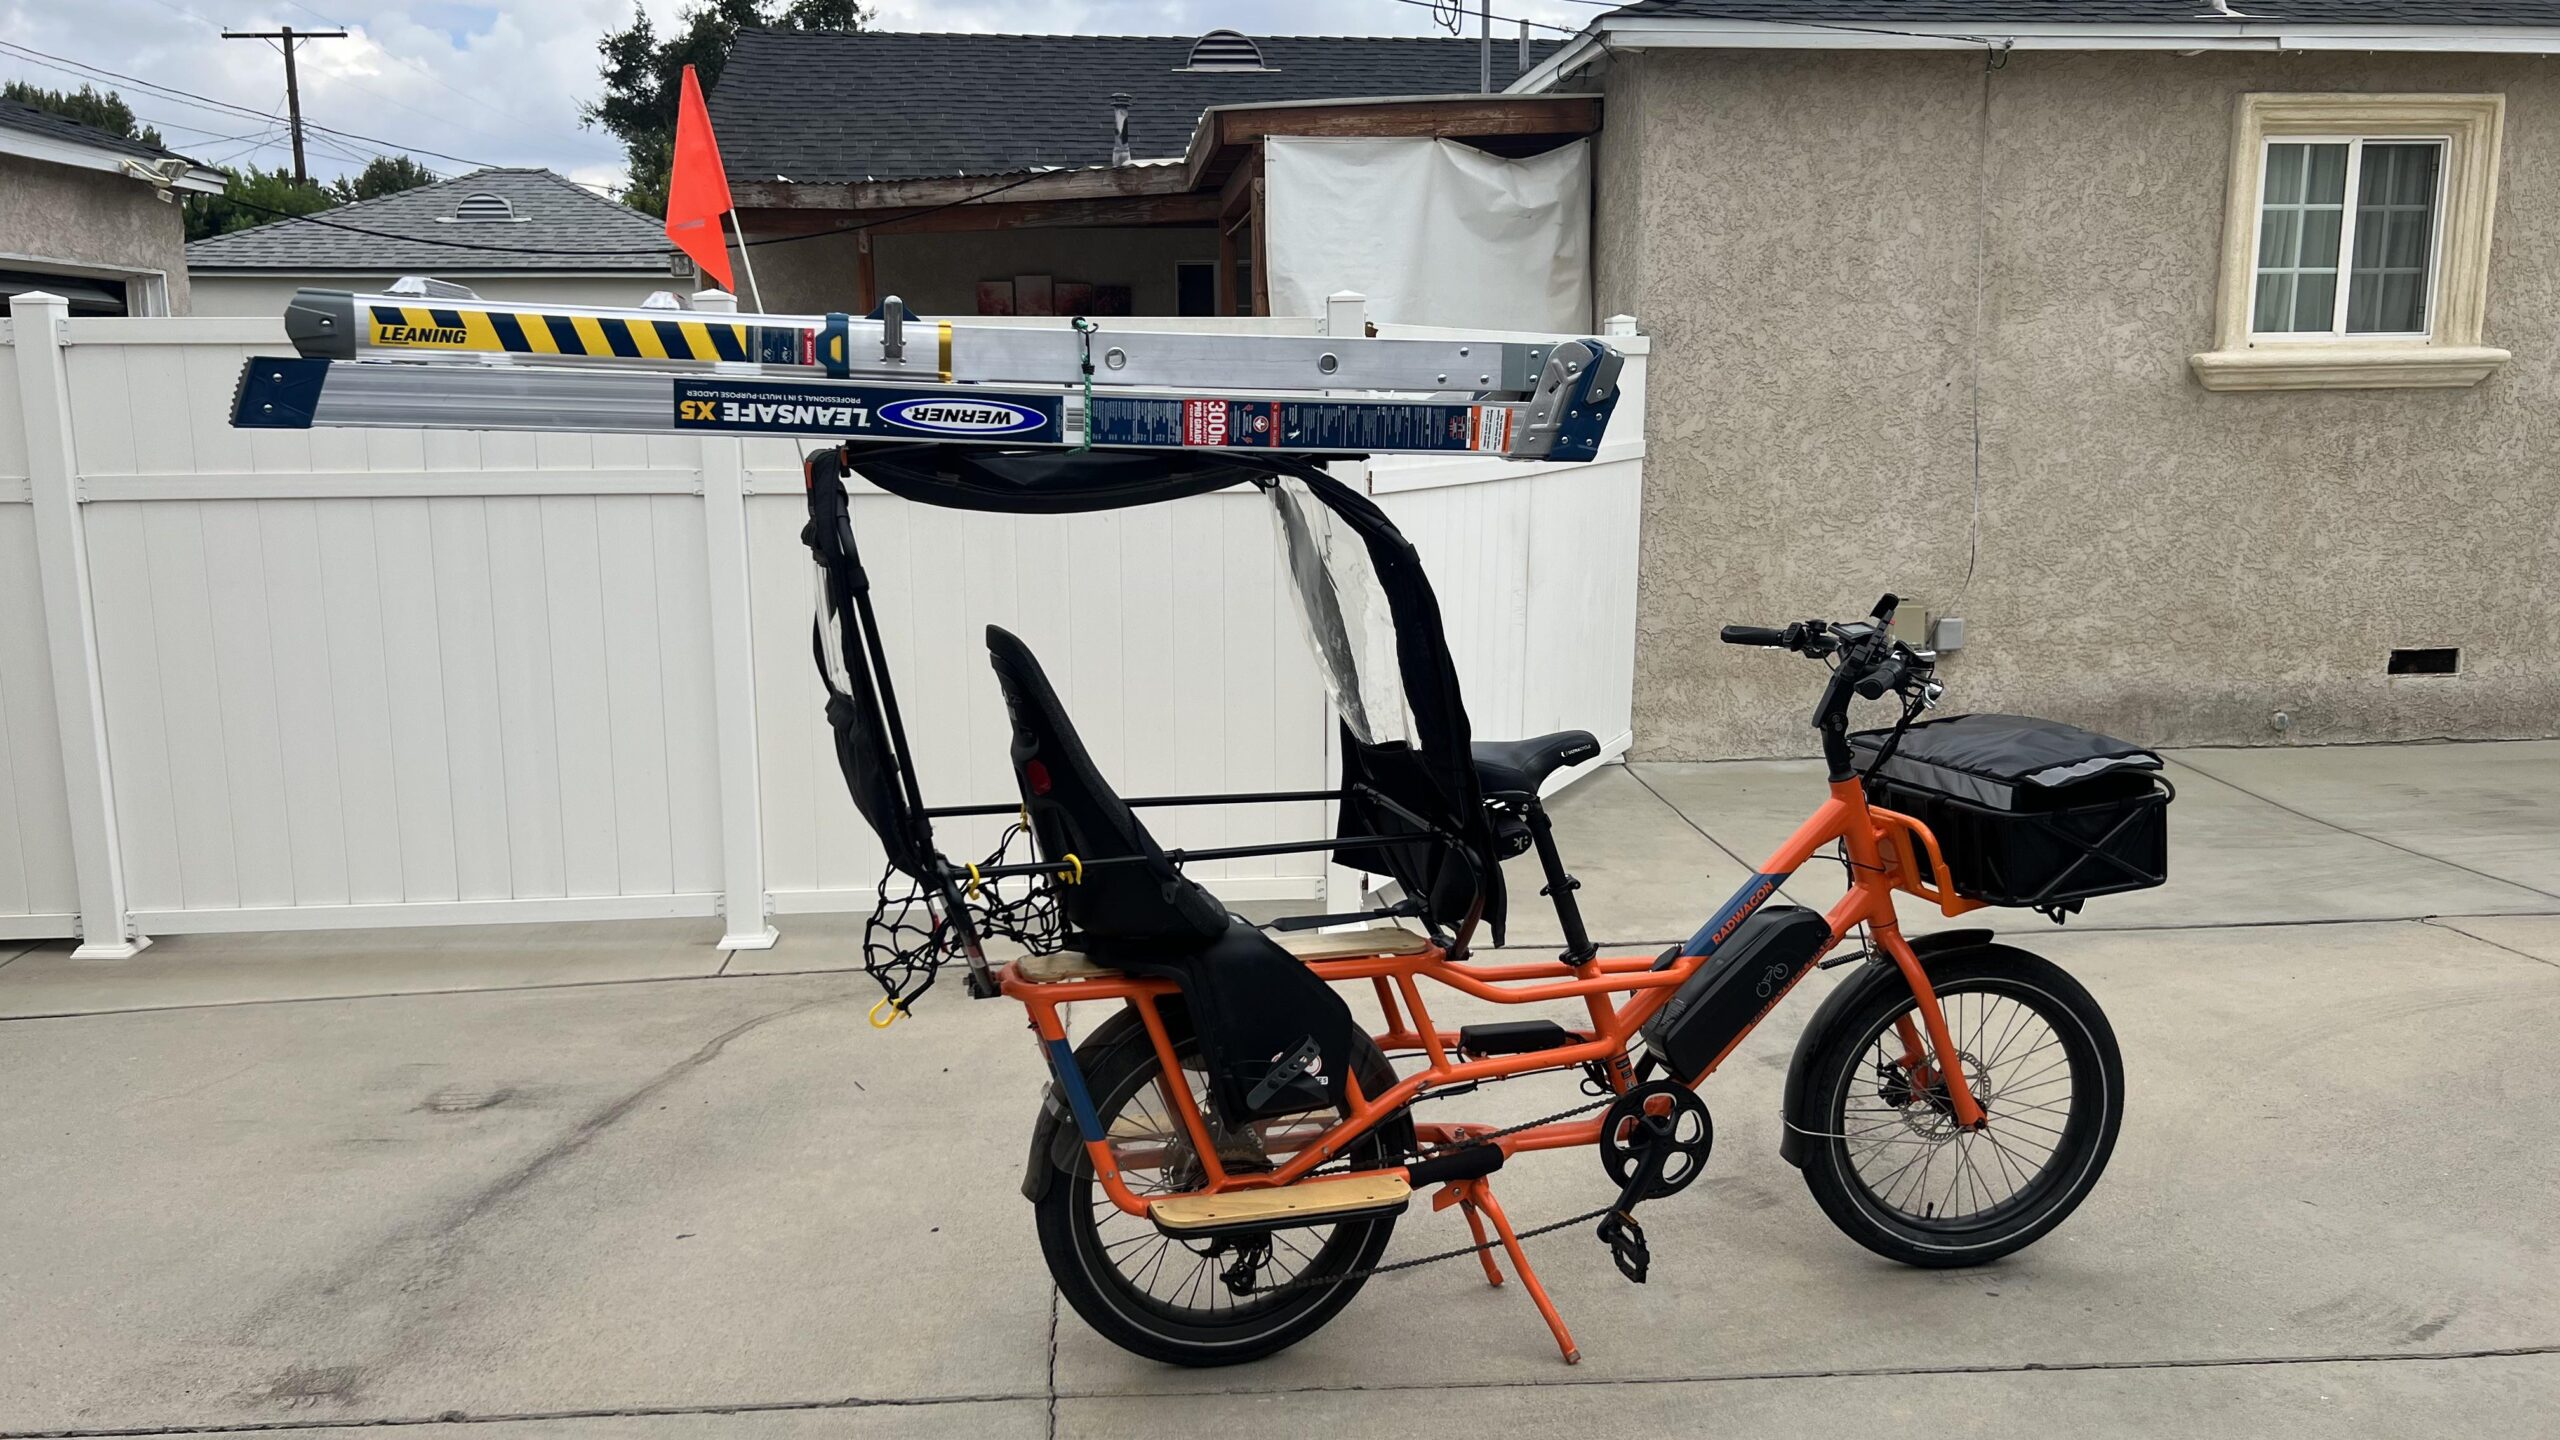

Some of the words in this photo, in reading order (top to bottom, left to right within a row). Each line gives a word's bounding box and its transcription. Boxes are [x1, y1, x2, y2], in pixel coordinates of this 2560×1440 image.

[379, 325, 468, 344] LEANING
[686, 389, 719, 398] LADDER
[720, 391, 782, 401] MULTI-PURPOSE
[804, 395, 861, 404] PROFESSIONAL
[680, 400, 717, 420] X5
[723, 402, 871, 427] LEANSAFE
[911, 407, 1012, 425] WERNER
[1194, 401, 1202, 418] PRO
[1194, 418, 1202, 445] GRADE
[1208, 401, 1226, 445] 300lb
[1711, 881, 1774, 945] RADWAGON
